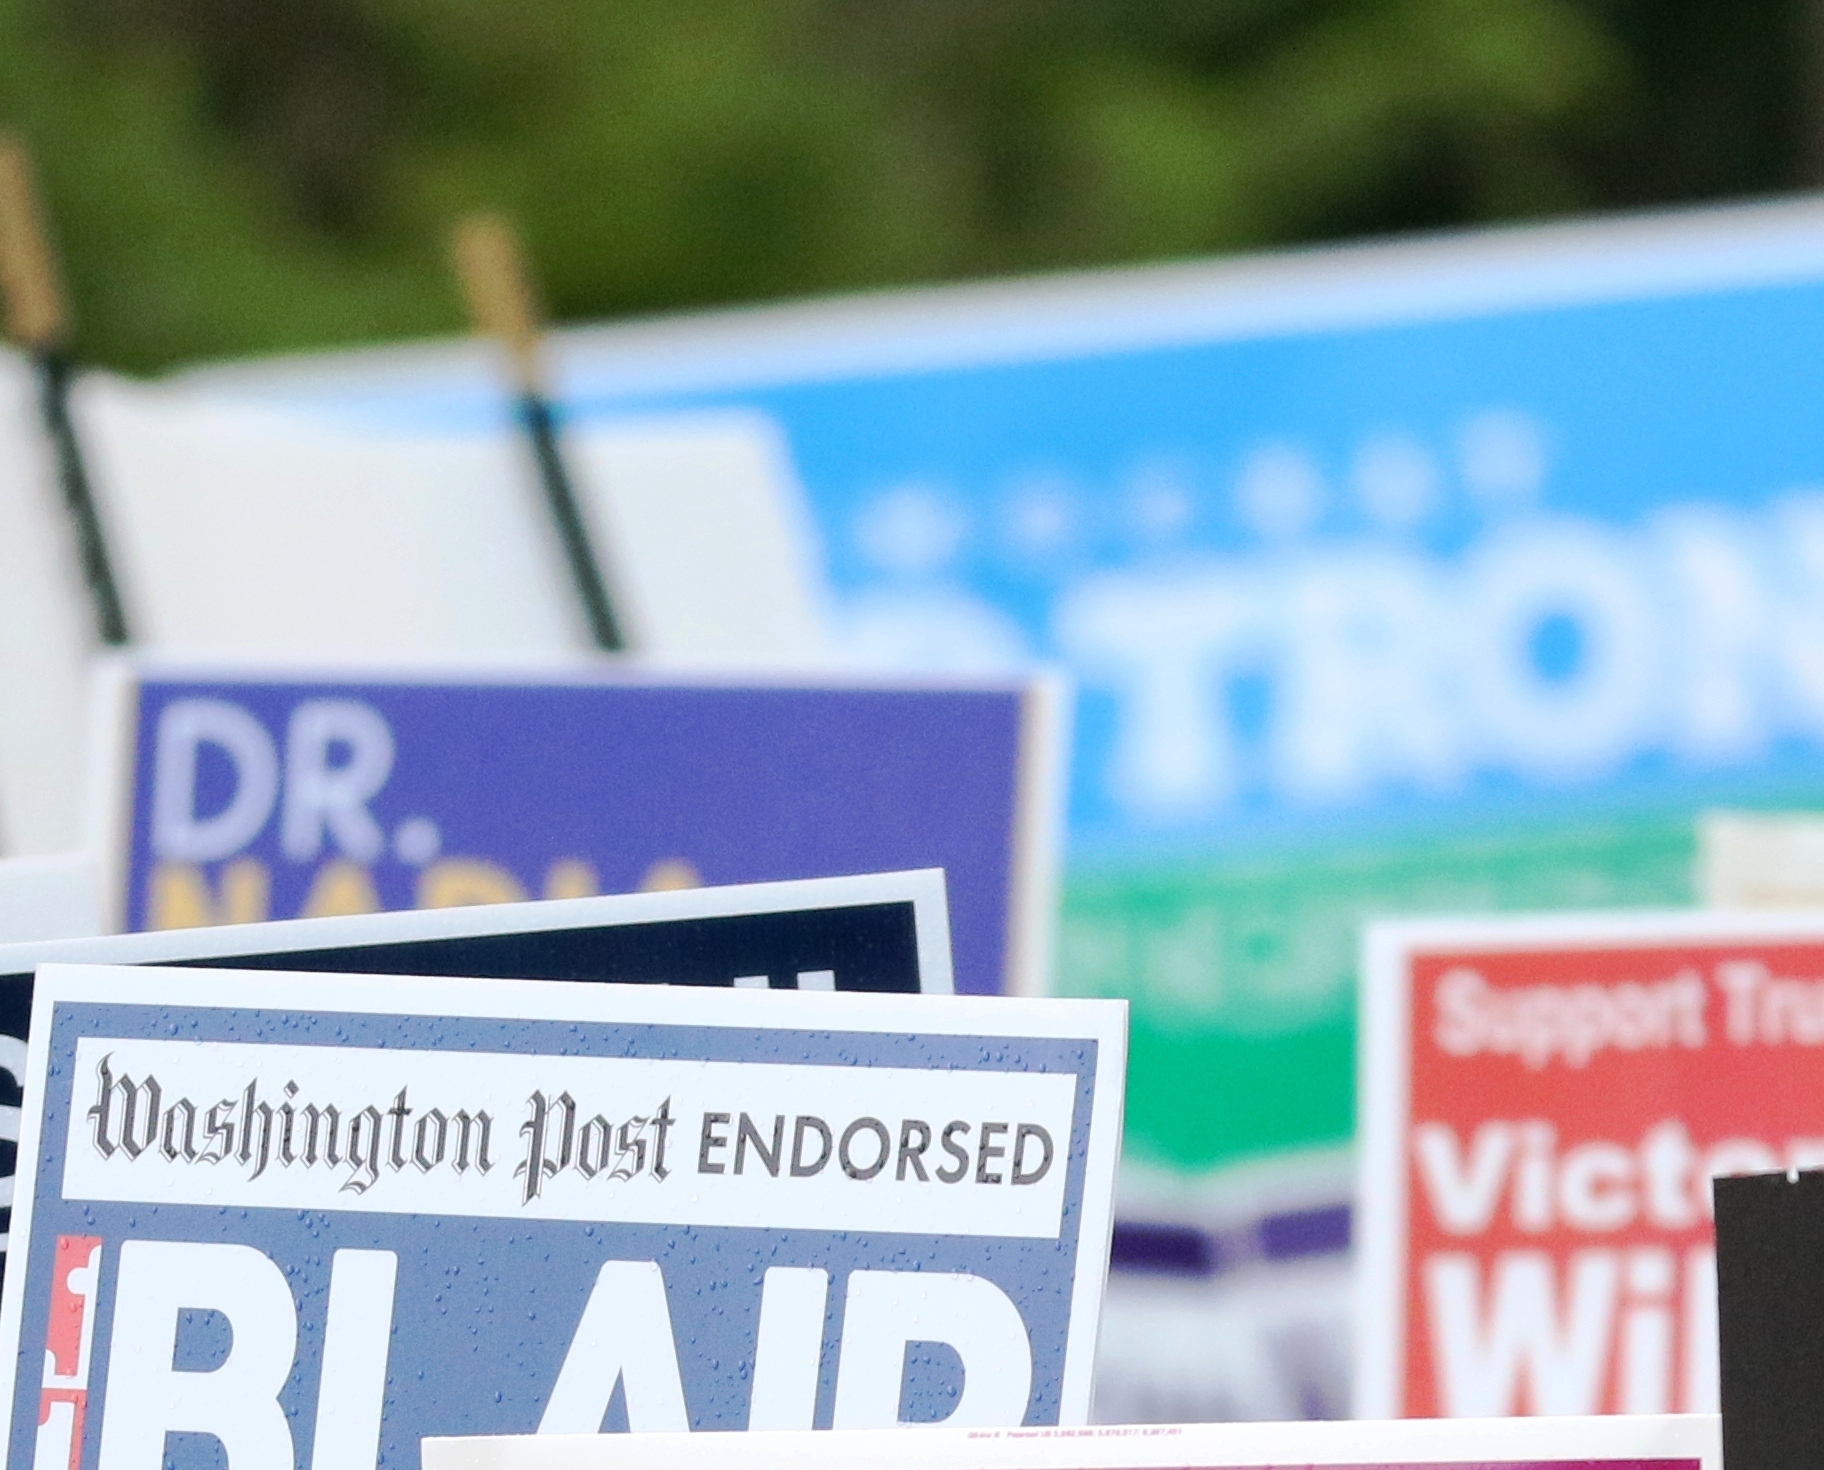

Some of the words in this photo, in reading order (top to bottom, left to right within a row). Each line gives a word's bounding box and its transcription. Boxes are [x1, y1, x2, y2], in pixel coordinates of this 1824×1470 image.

[152, 696, 442, 868] DR.
[1436, 963, 1707, 1070] Support
[86, 1053, 495, 1196] Washington
[512, 1089, 677, 1207] Post
[696, 1112, 1055, 1188] ENDORSED
